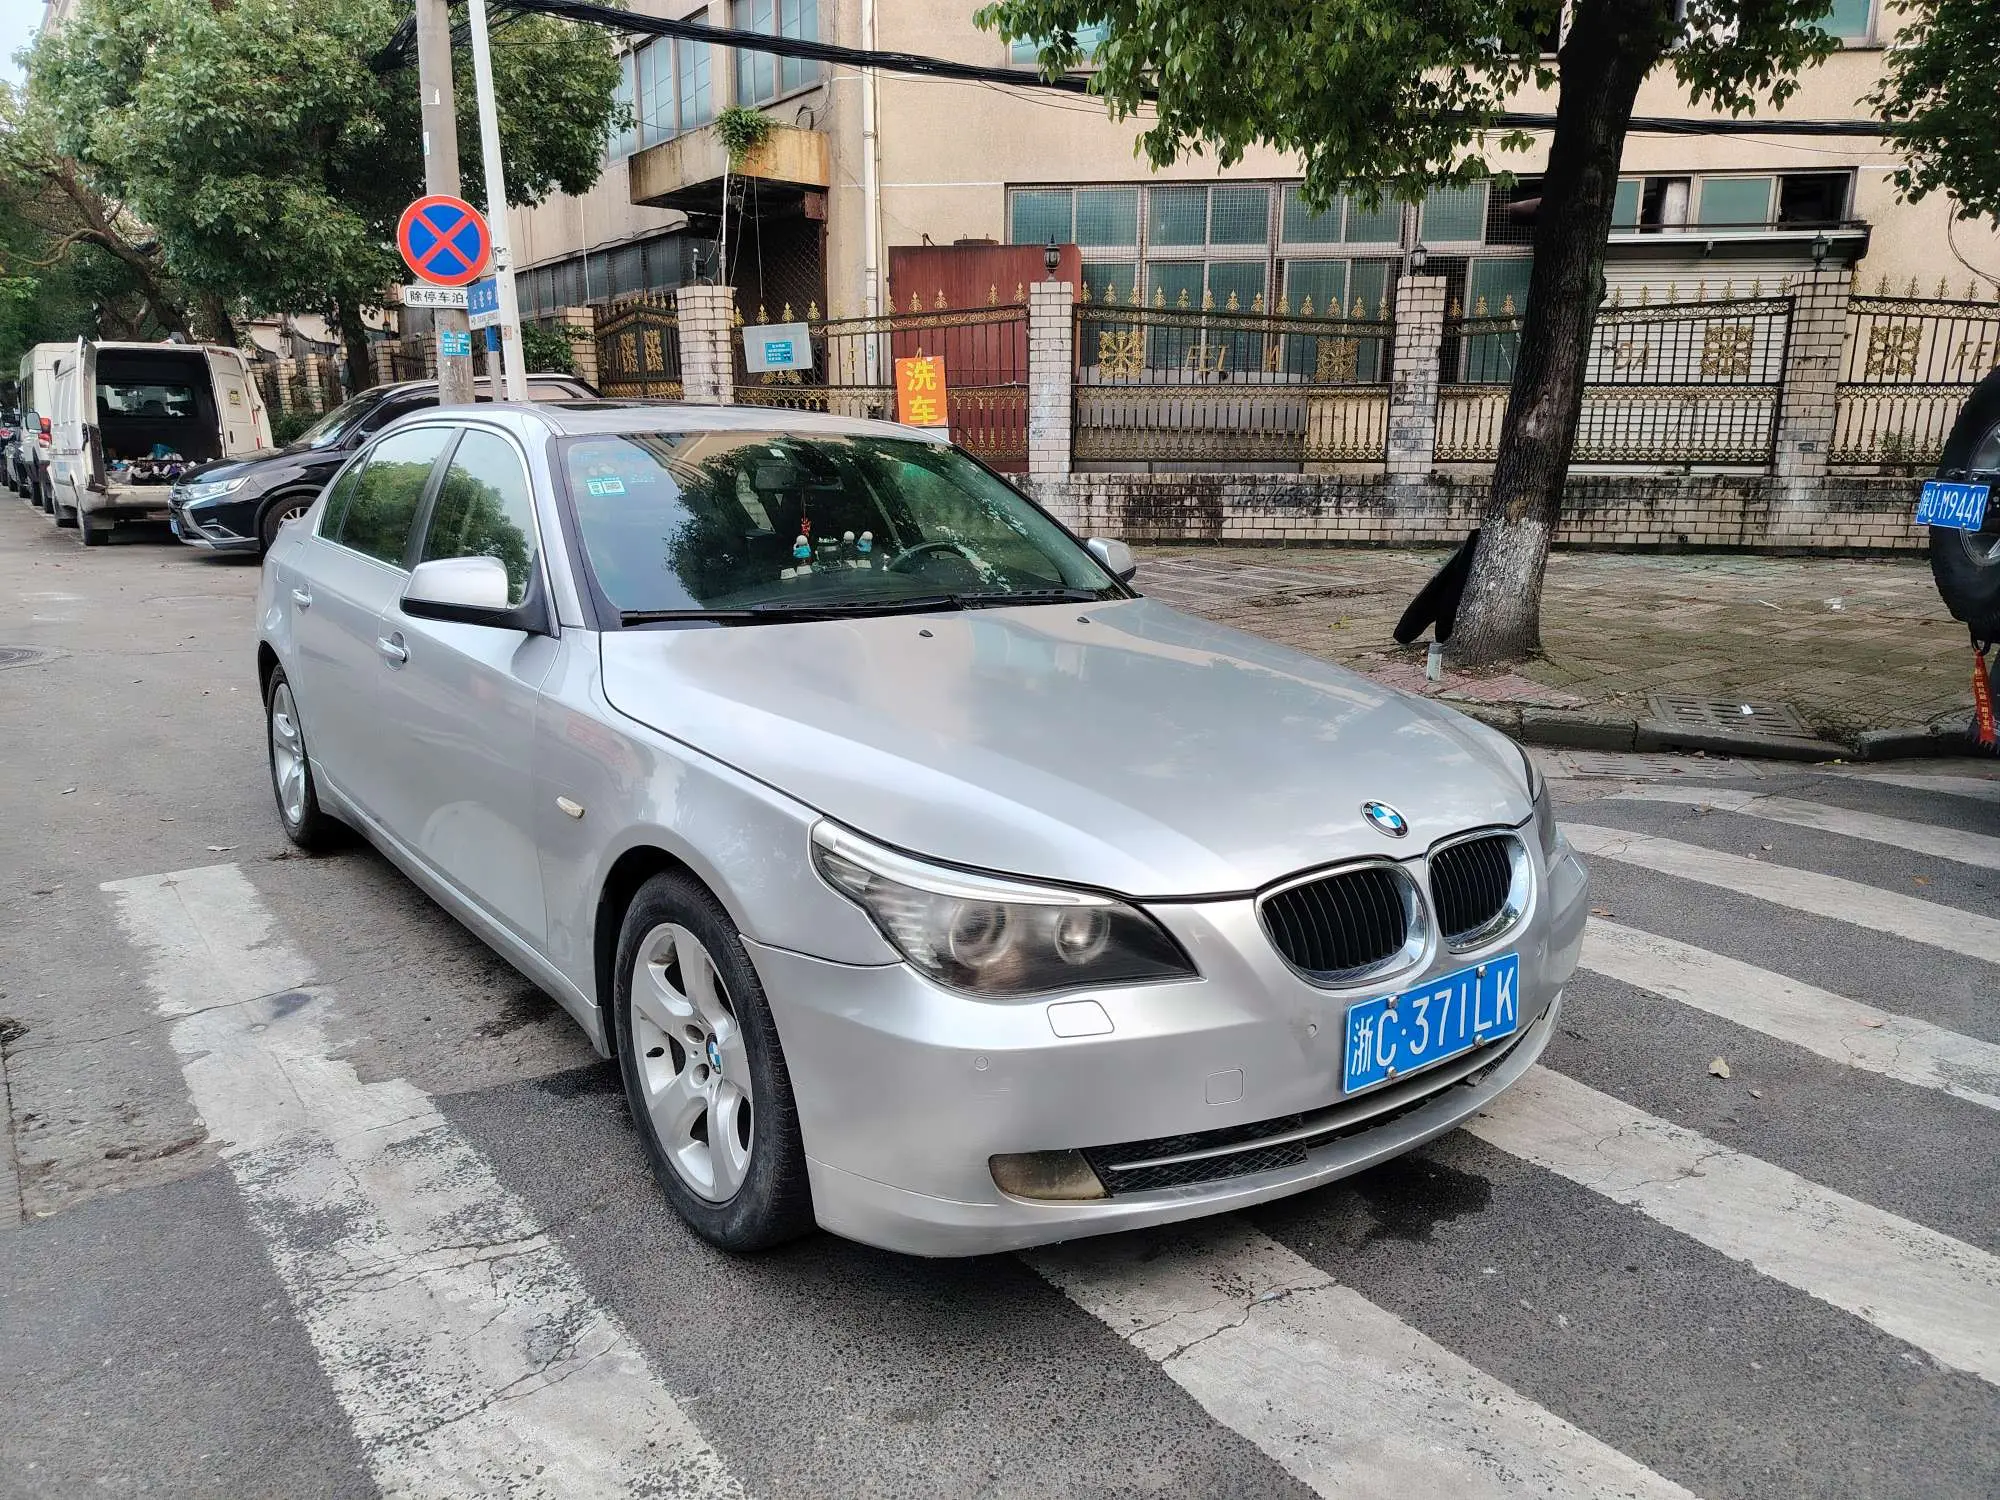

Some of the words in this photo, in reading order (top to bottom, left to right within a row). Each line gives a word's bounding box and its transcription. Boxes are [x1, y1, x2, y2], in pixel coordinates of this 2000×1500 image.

[410, 290, 469, 304] 除停车泊
[905, 359, 938, 425] 洗车
